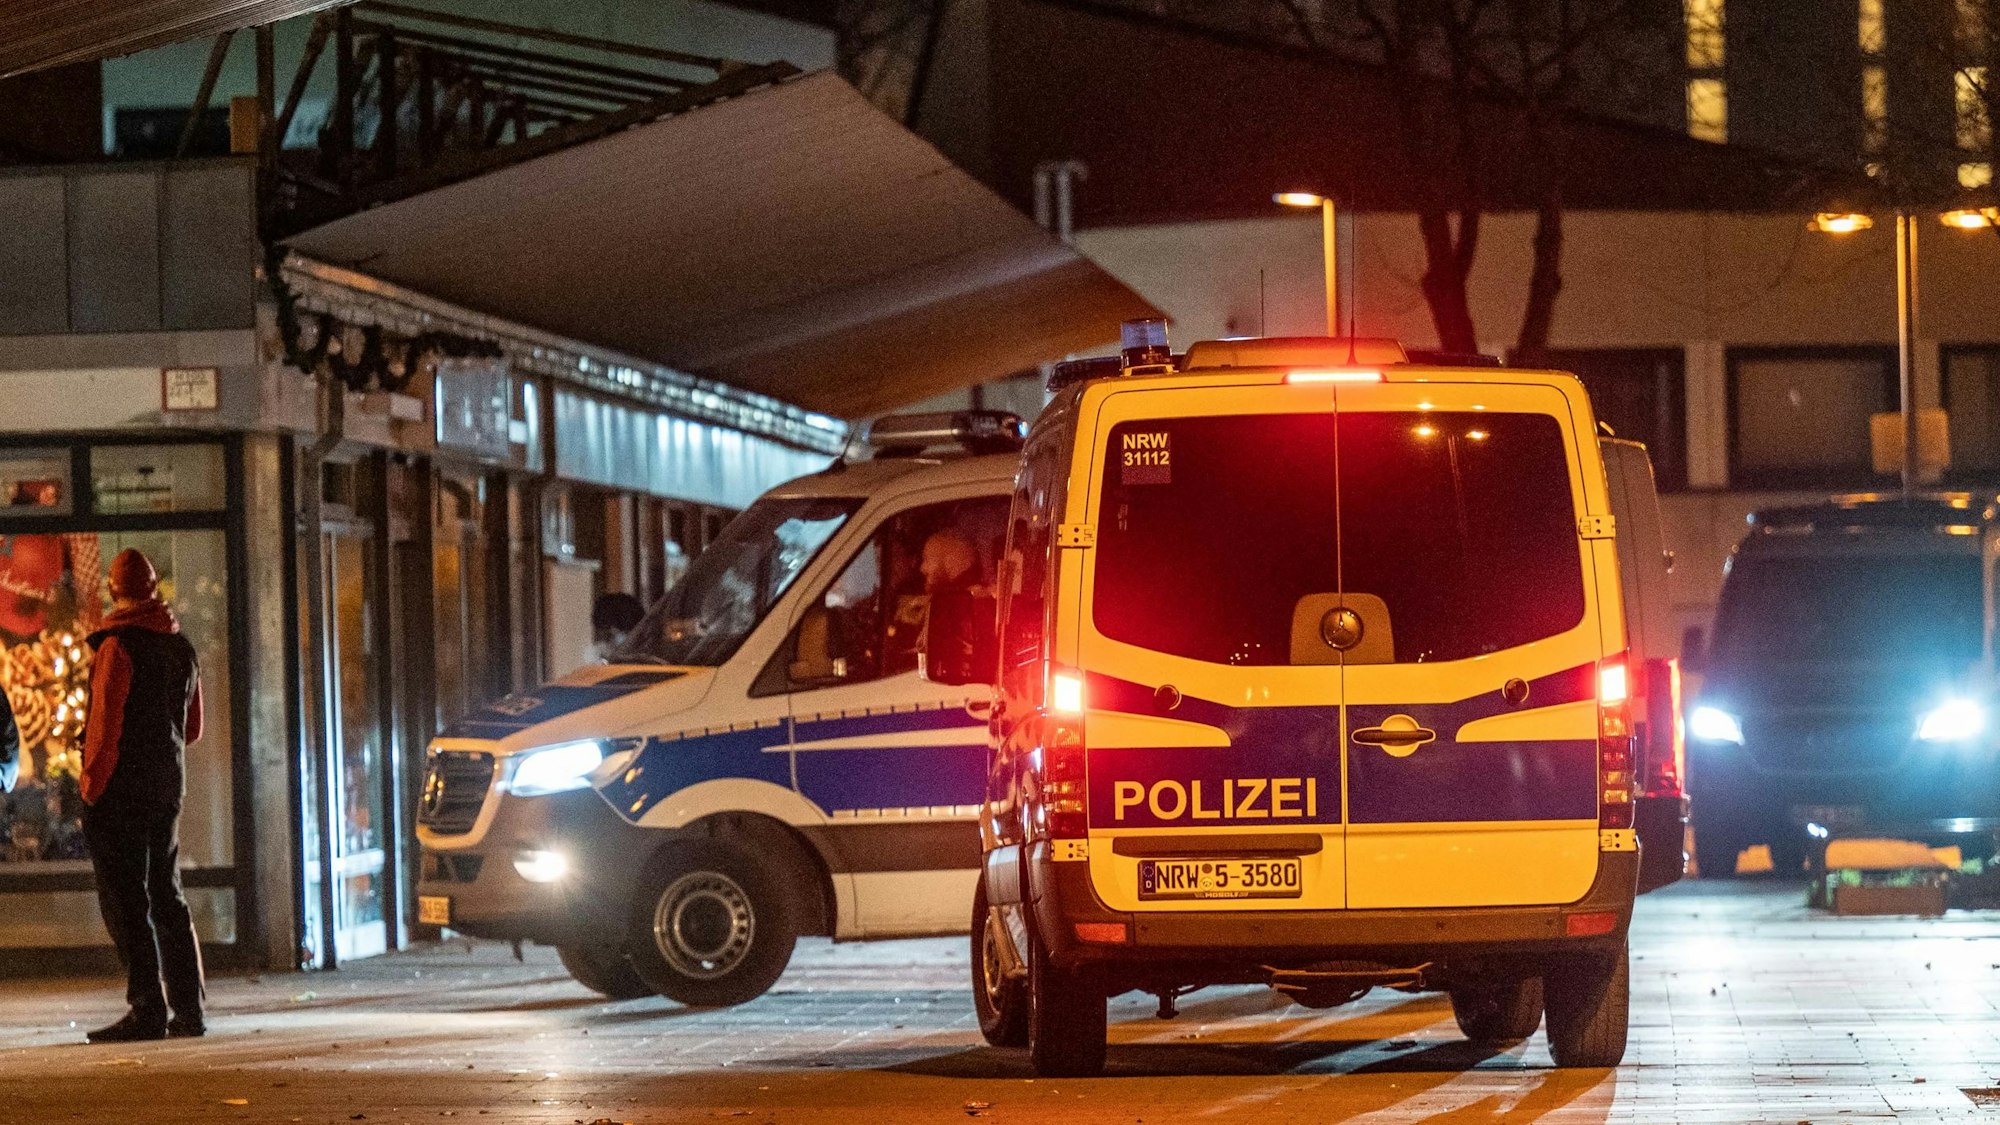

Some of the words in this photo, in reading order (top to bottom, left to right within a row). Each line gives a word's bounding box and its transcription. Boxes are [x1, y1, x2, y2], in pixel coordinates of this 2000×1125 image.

[1123, 433, 1168, 449] NRW
[1124, 451, 1169, 466] 31112
[1114, 778, 1317, 820] POLIZEI
[1156, 864, 1199, 889] NRW
[1215, 863, 1297, 888] 5-3580
[1145, 880, 1152, 889] D
